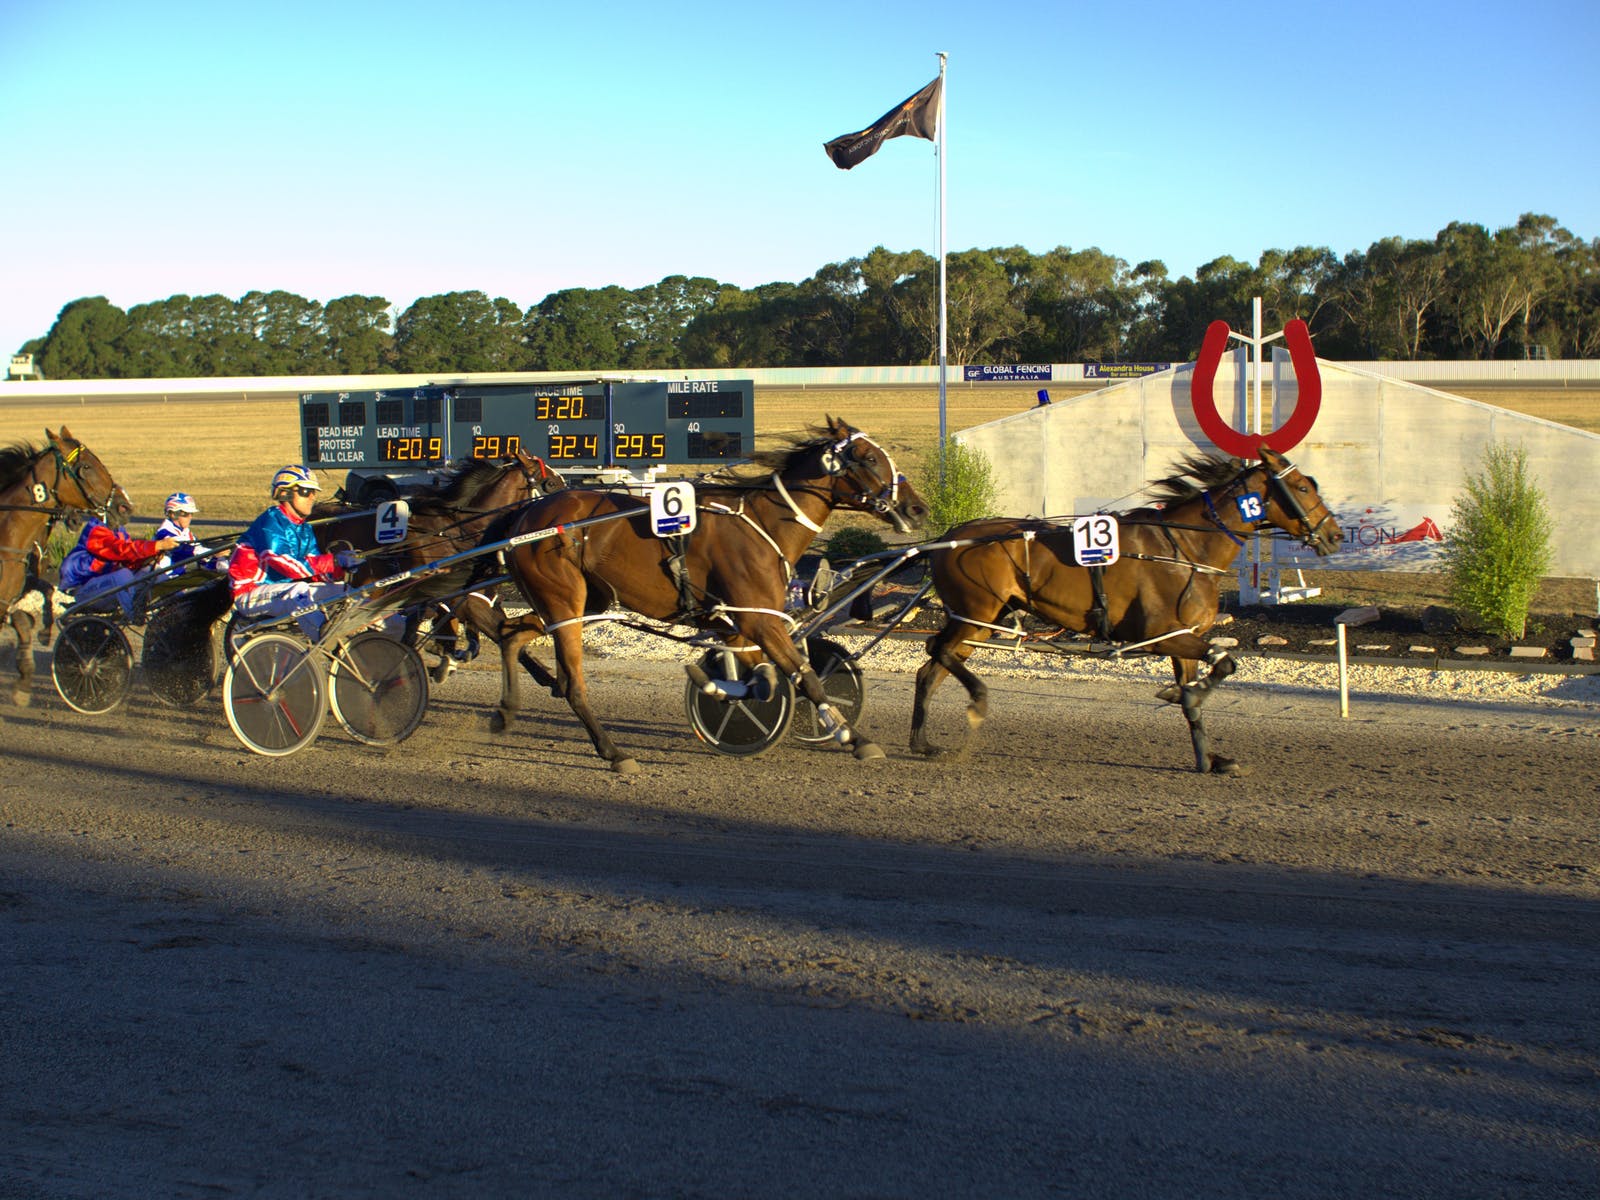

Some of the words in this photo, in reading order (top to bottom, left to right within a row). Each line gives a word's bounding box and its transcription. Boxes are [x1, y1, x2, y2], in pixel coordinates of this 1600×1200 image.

[983, 366, 1014, 374] GLOBAL
[1016, 365, 1050, 373] FENCING
[1100, 364, 1133, 372] Alexandra
[1134, 364, 1155, 372] House
[534, 386, 560, 397] RACE
[562, 385, 583, 396] TIME
[667, 382, 690, 393] MILE
[692, 381, 719, 393] RATE
[318, 426, 341, 437] DEAD
[342, 426, 365, 437] HEAT
[376, 427, 399, 438] LEAD
[401, 427, 421, 437] TIME
[472, 425, 482, 436] 1Q
[547, 424, 560, 435] 2Q
[614, 423, 625, 434] 3Q
[687, 422, 700, 433] 4Q
[319, 439, 356, 450] PROTEST
[387, 438, 441, 459] 1:20.9
[550, 435, 598, 458] 32.4
[615, 435, 665, 457] 29.5
[320, 452, 336, 462] ALL
[337, 451, 365, 462] CLEAR
[33, 484, 46, 502] 8
[663, 487, 682, 517] 6
[1240, 496, 1262, 518] 13
[381, 503, 399, 528] 4
[1078, 519, 1112, 548] 13
